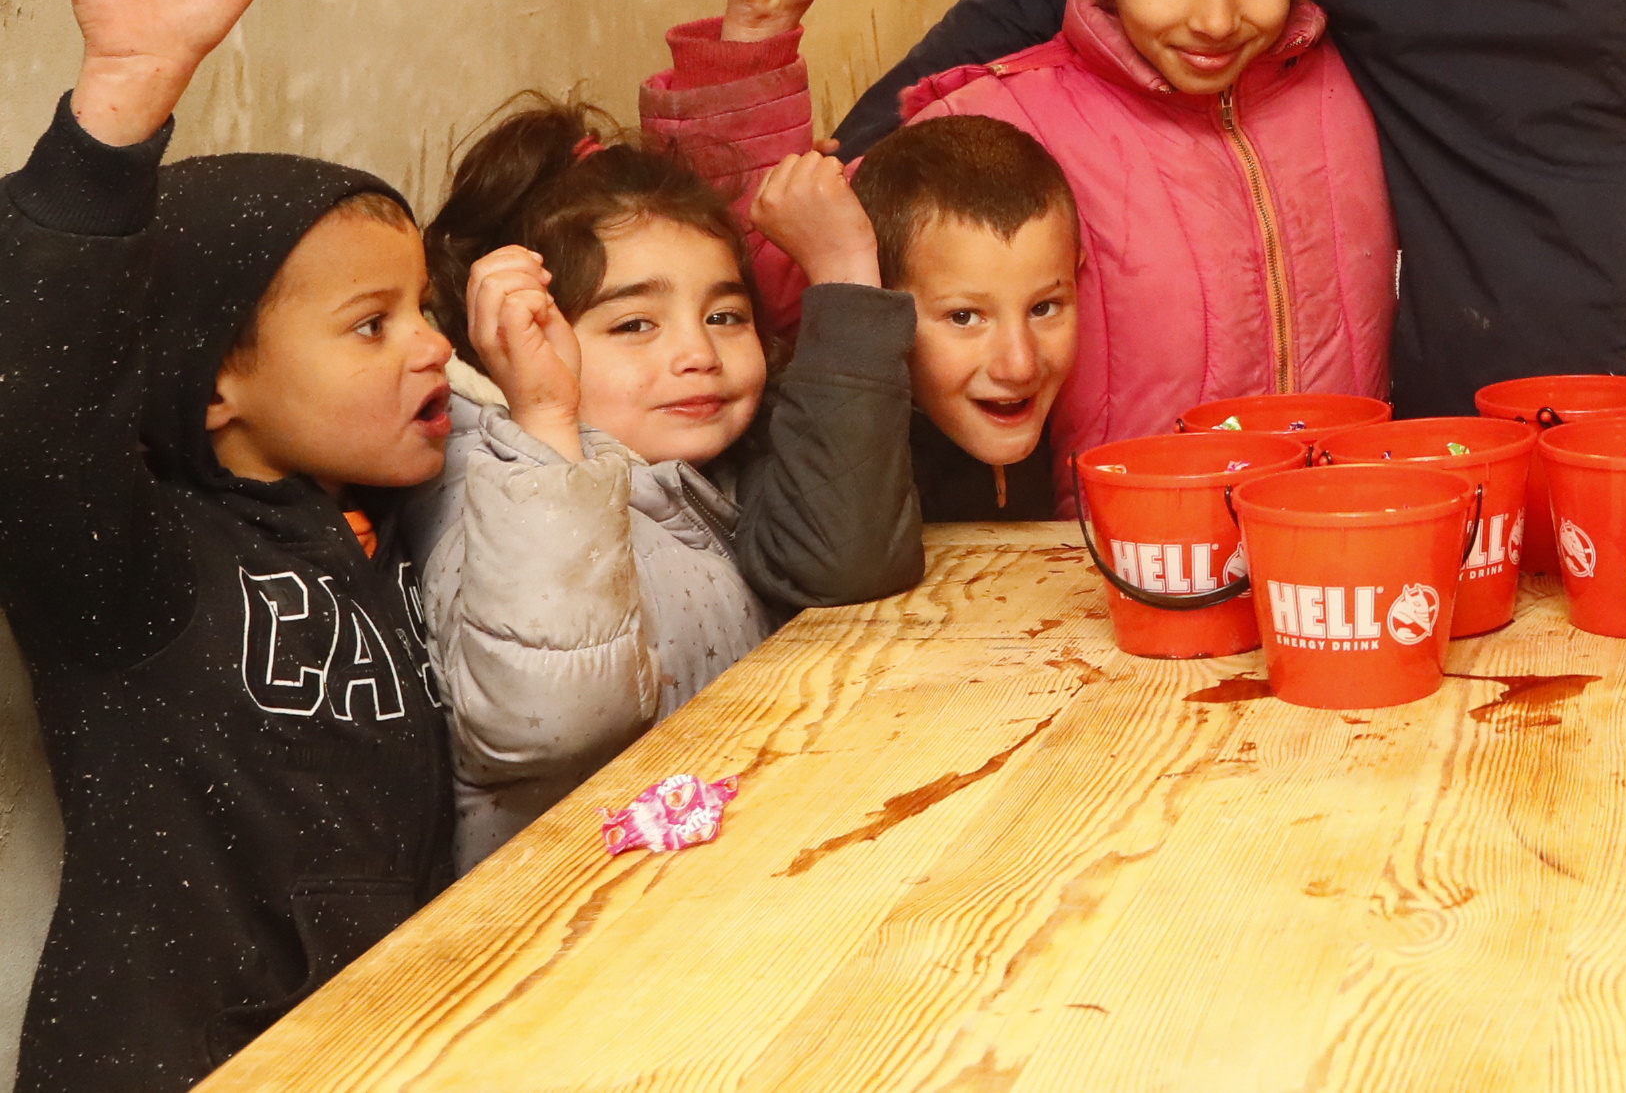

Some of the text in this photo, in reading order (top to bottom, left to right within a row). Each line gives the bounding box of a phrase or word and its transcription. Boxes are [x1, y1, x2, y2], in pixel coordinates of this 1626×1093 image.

[1110, 539, 1217, 593] HELL
[1470, 564, 1503, 579] DRINK
[1267, 579, 1381, 639] HELL
[1276, 634, 1380, 652] ENERGY DRINK
